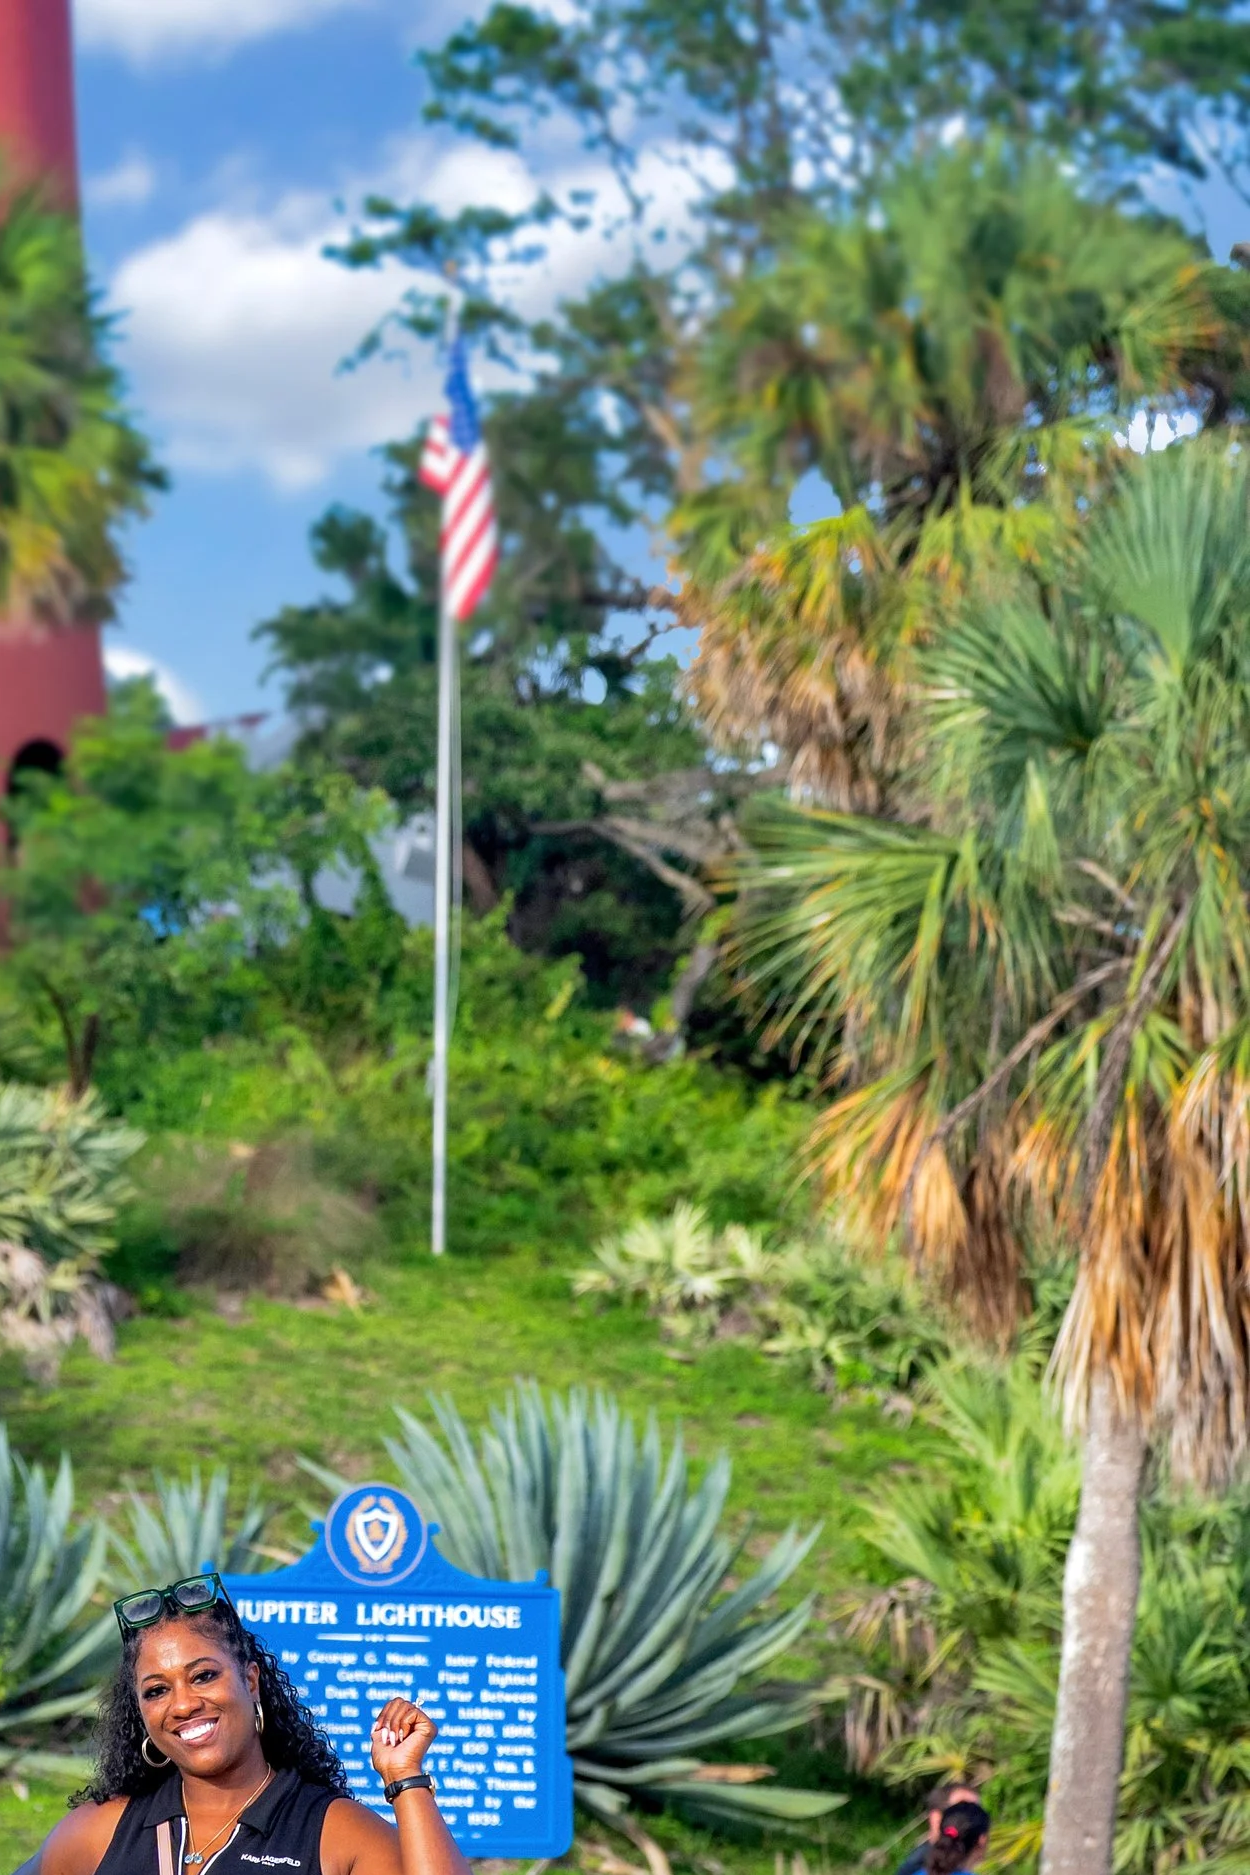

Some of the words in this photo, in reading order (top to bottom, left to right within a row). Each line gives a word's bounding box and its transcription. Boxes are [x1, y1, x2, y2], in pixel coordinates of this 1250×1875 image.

[237, 1599, 337, 1624] JUPITER
[357, 1602, 522, 1628] LIGHTHOUSE
[307, 1651, 358, 1667] George
[485, 1653, 538, 1668] Federal
[438, 1670, 469, 1685] First
[488, 1671, 538, 1688] lighted
[325, 1684, 359, 1700] Dark
[417, 1689, 440, 1702] the
[447, 1689, 474, 1702] War
[480, 1689, 538, 1704] Between
[458, 1707, 505, 1720] hidden
[517, 1707, 537, 1723] by
[484, 1777, 537, 1791] Thomas
[484, 1795, 502, 1809] by
[513, 1796, 537, 1809] the
[241, 1854, 261, 1863] KARL
[261, 1855, 301, 1867] LAGERFELD
